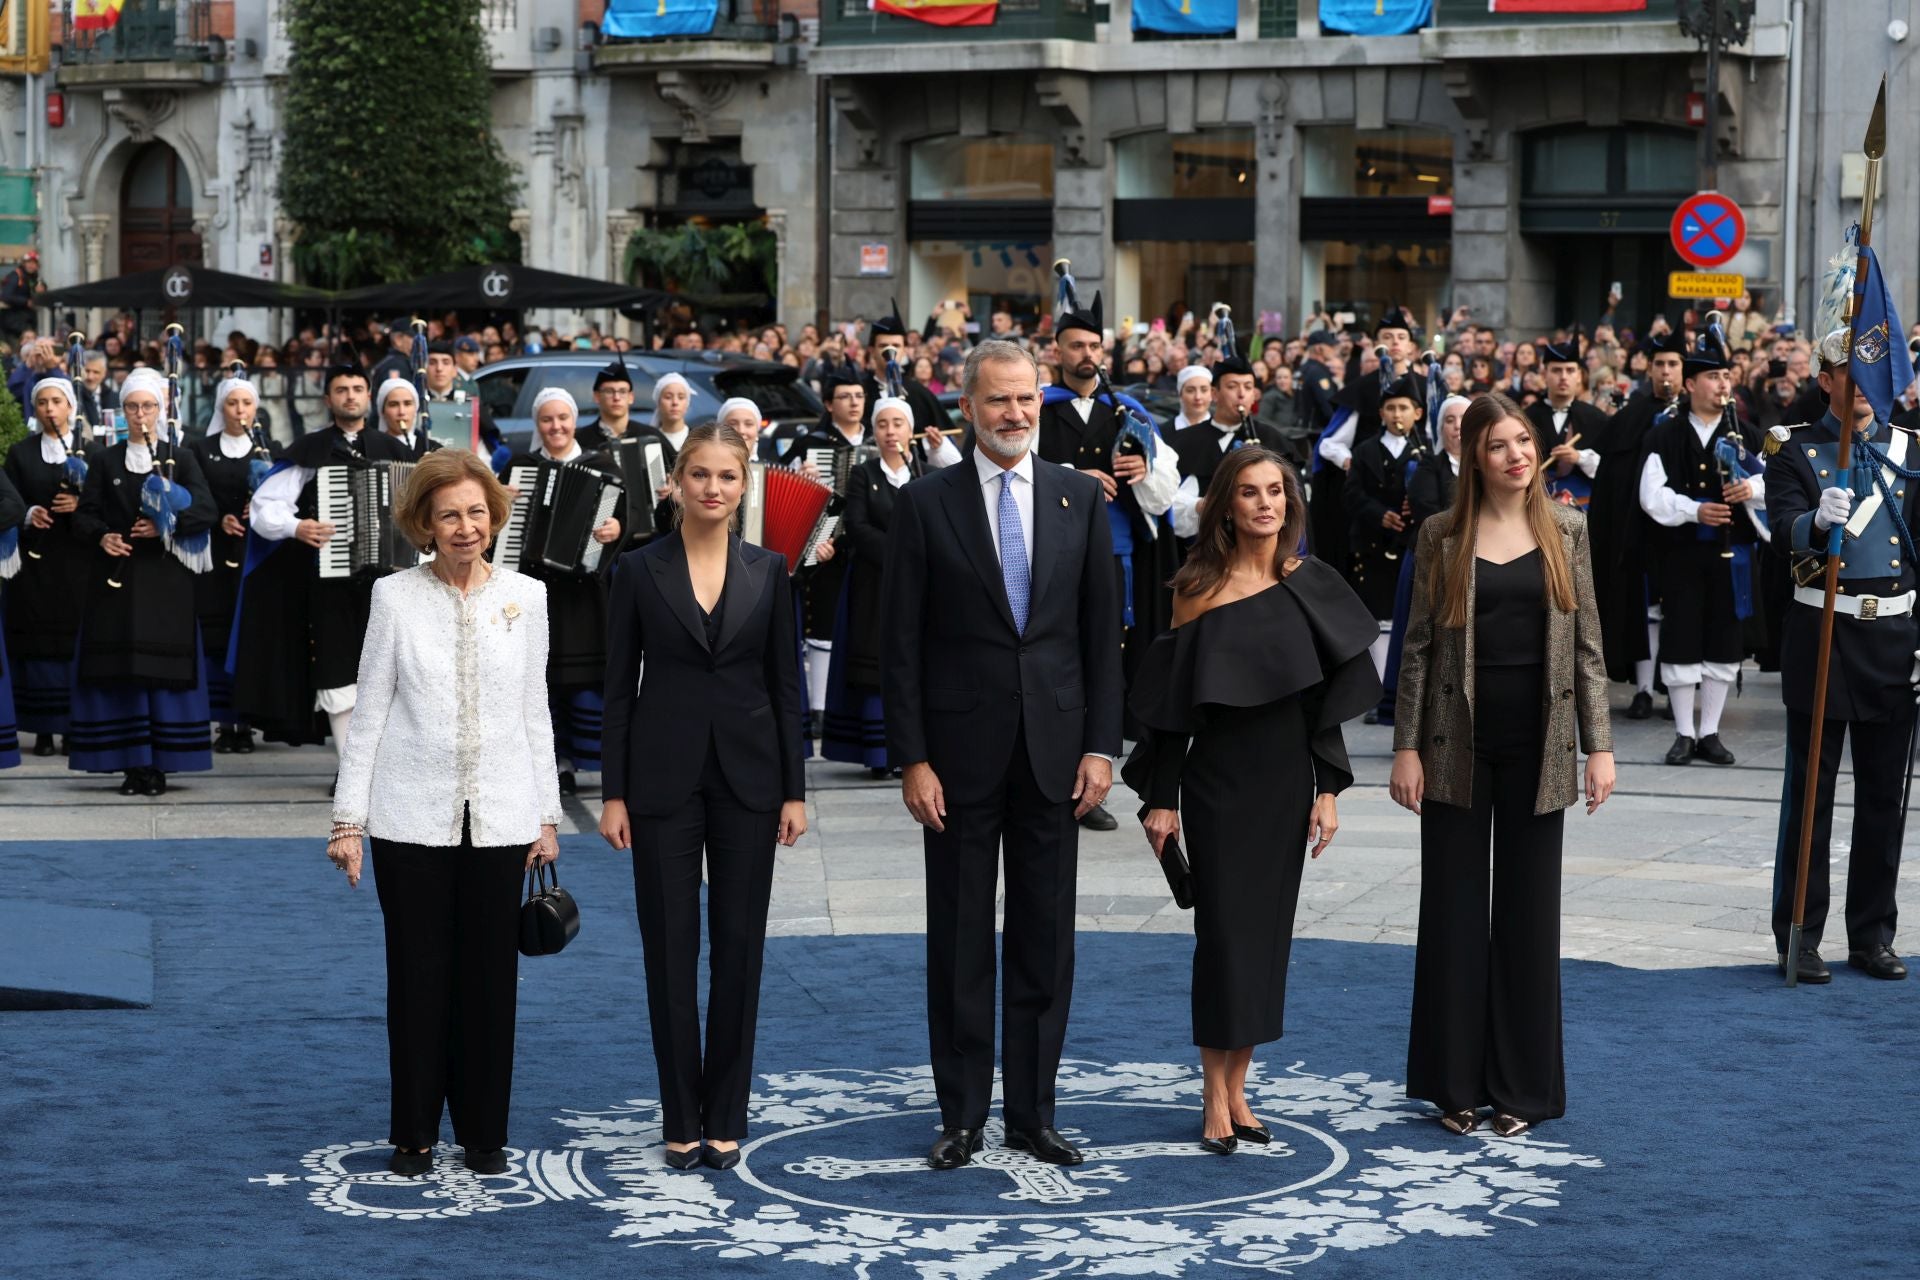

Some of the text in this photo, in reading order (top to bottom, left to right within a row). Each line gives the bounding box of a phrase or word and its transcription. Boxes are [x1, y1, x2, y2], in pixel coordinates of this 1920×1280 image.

[1676, 274, 1738, 283] AUTORIZADO
[1676, 286, 1738, 294] PARADA TAXI
